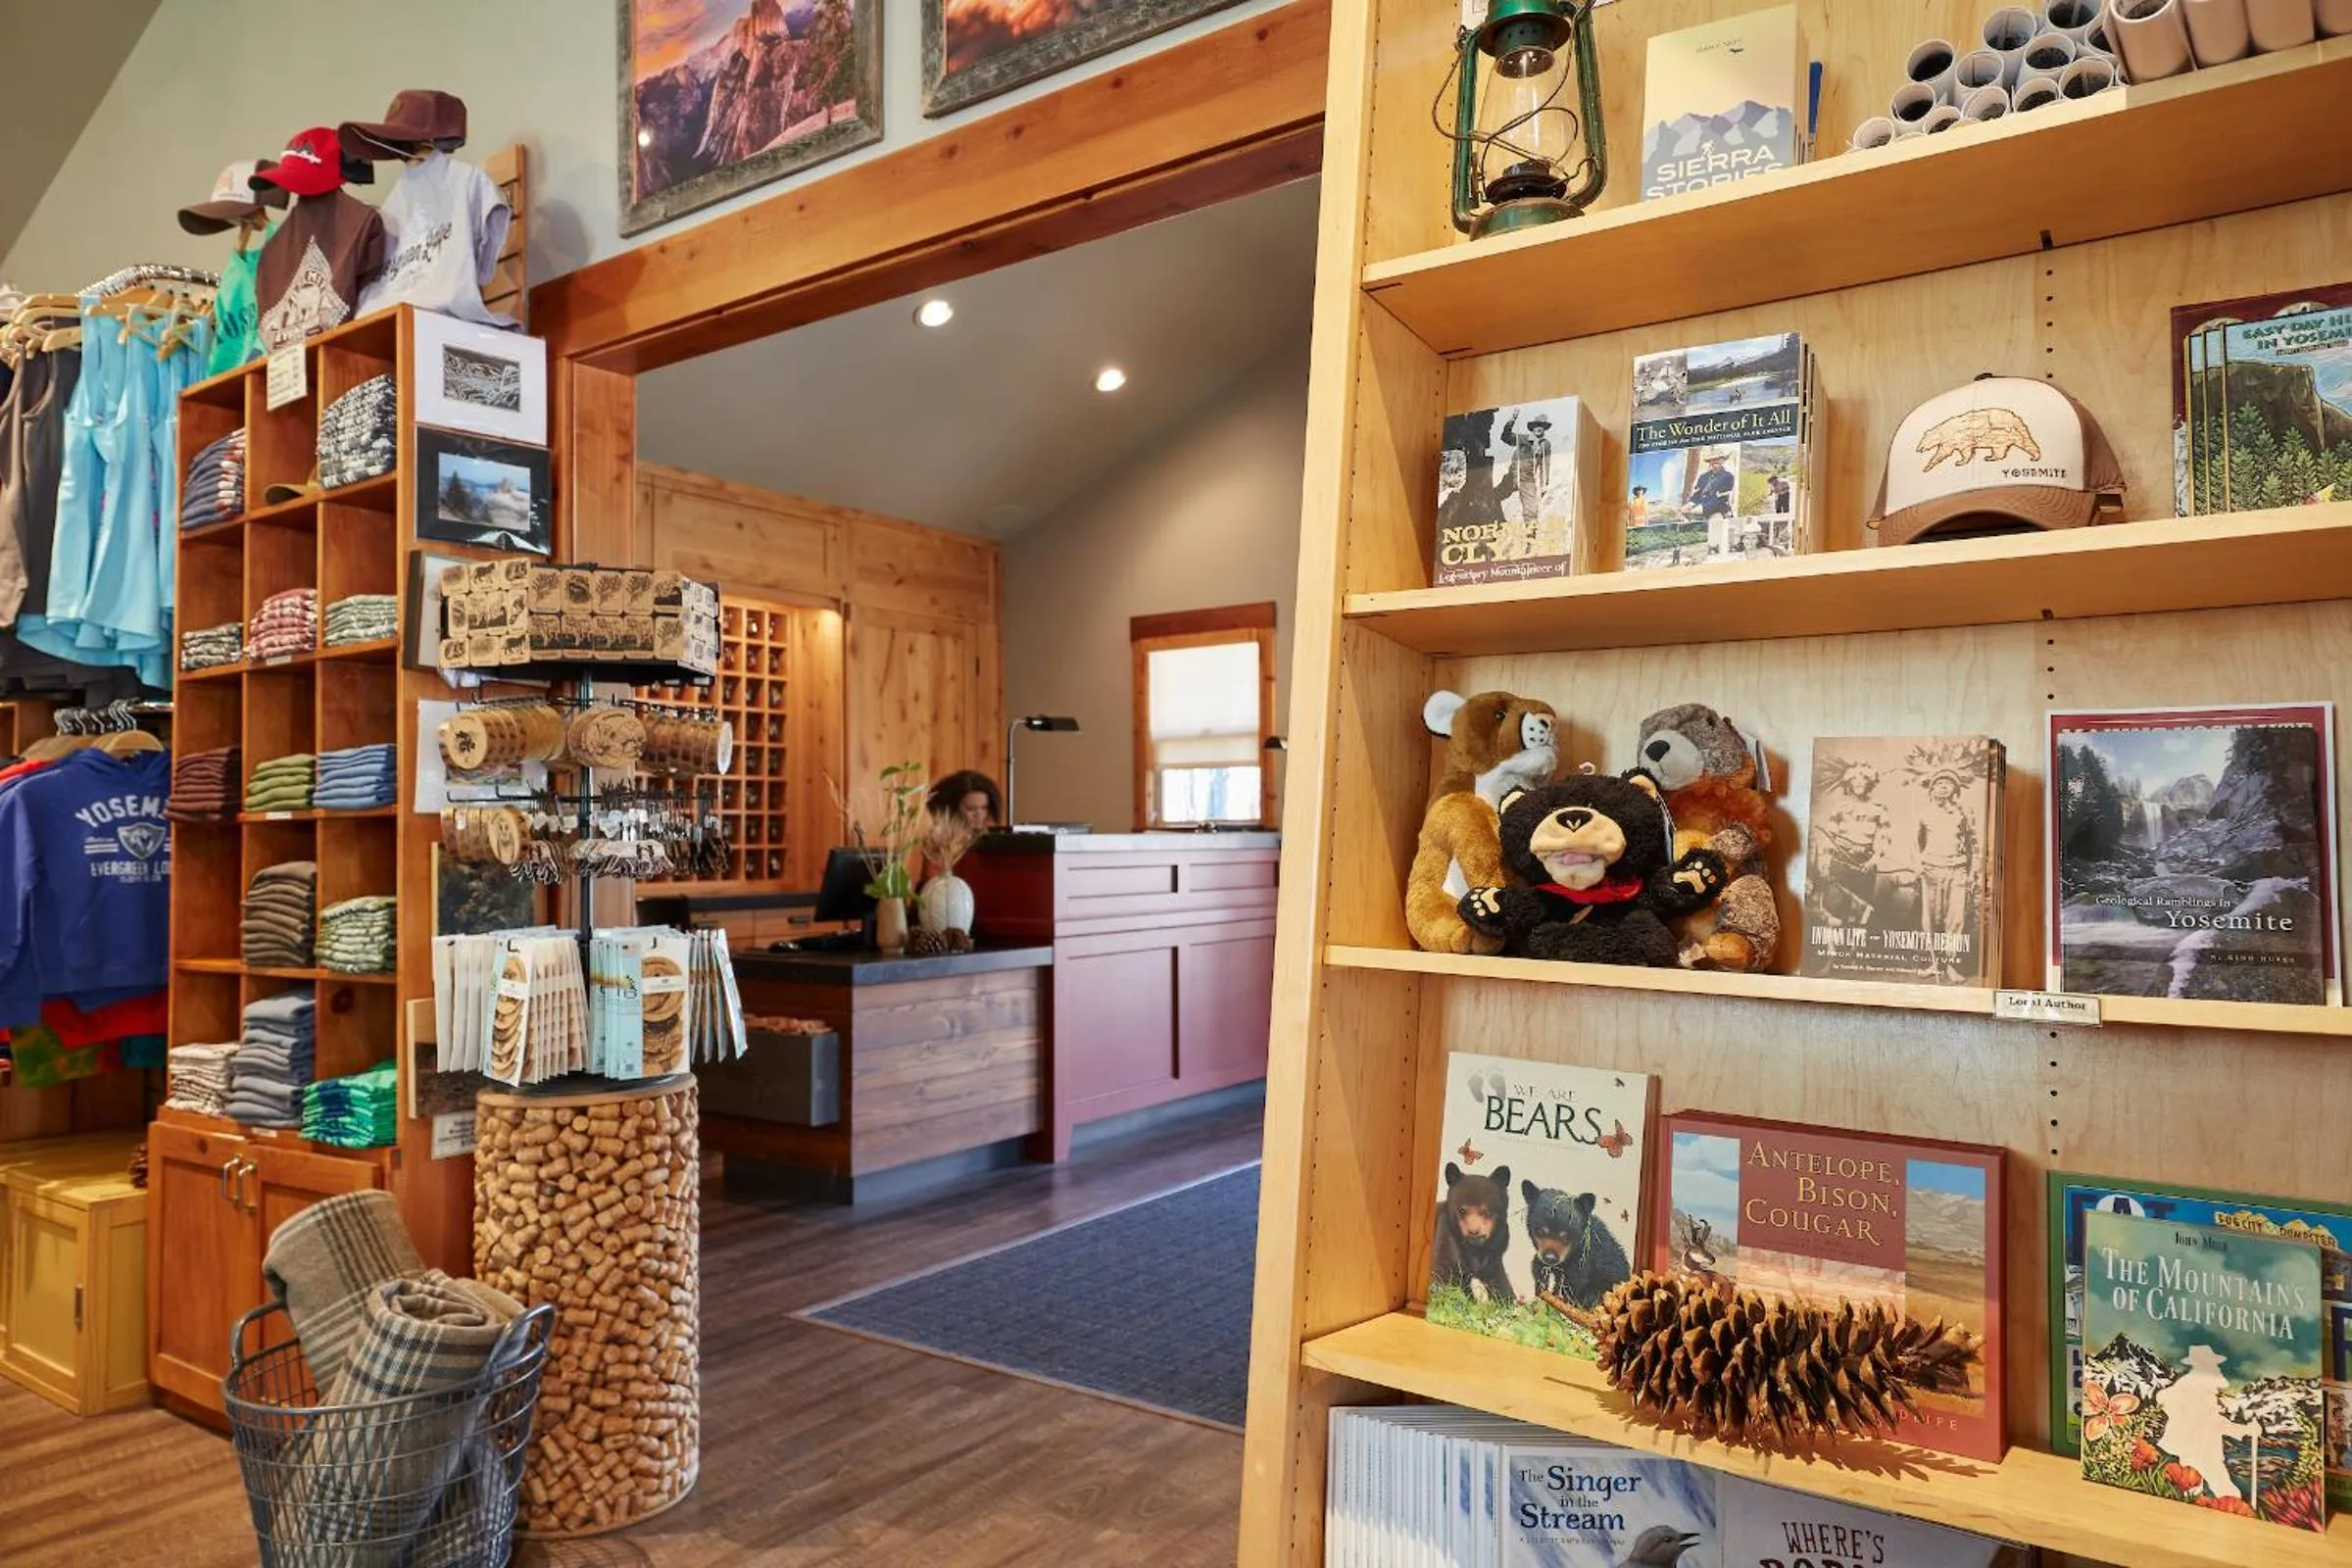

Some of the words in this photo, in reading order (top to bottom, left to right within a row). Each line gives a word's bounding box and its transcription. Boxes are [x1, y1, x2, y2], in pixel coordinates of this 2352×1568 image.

[1656, 144, 1776, 183] SIERRA
[1637, 426, 1666, 442] The
[1668, 418, 1728, 437] Wonder
[1731, 413, 1749, 430] of
[1752, 413, 1763, 427] It
[1768, 409, 1791, 425] All
[2001, 467, 2068, 479] YOSEMITE
[1555, 561, 1567, 576] of
[74, 795, 169, 828] YOSEM
[2095, 894, 2153, 907] Geological
[2156, 896, 2217, 909] Ramblings
[2219, 898, 2231, 907] in
[2165, 910, 2293, 932] Yosemite
[1811, 926, 1844, 946] INDIAN
[1934, 932, 1971, 954] REGION
[1856, 952, 1907, 961] MATERIAL
[2044, 999, 2086, 1010] Author
[1513, 1083, 1536, 1098] WE
[1548, 1088, 1576, 1102] ARE
[1484, 1095, 1602, 1145] BEARS
[1746, 1141, 1902, 1186] ANTELOPE,
[1796, 1176, 1897, 1217] BISON,
[1745, 1198, 1882, 1247] COUGAR
[2102, 1248, 2149, 1286] THE
[2157, 1254, 2306, 1310] MOUNTAINS
[2112, 1286, 2139, 1312] OF
[2146, 1286, 2294, 1341] CALIFORNIA
[1521, 1468, 1544, 1483] The
[1547, 1465, 1642, 1501] Singer
[1520, 1503, 1625, 1531] Stream
[1560, 1494, 1574, 1508] in
[1577, 1494, 1599, 1508] the
[1782, 1521, 1885, 1565] WHERE'S
